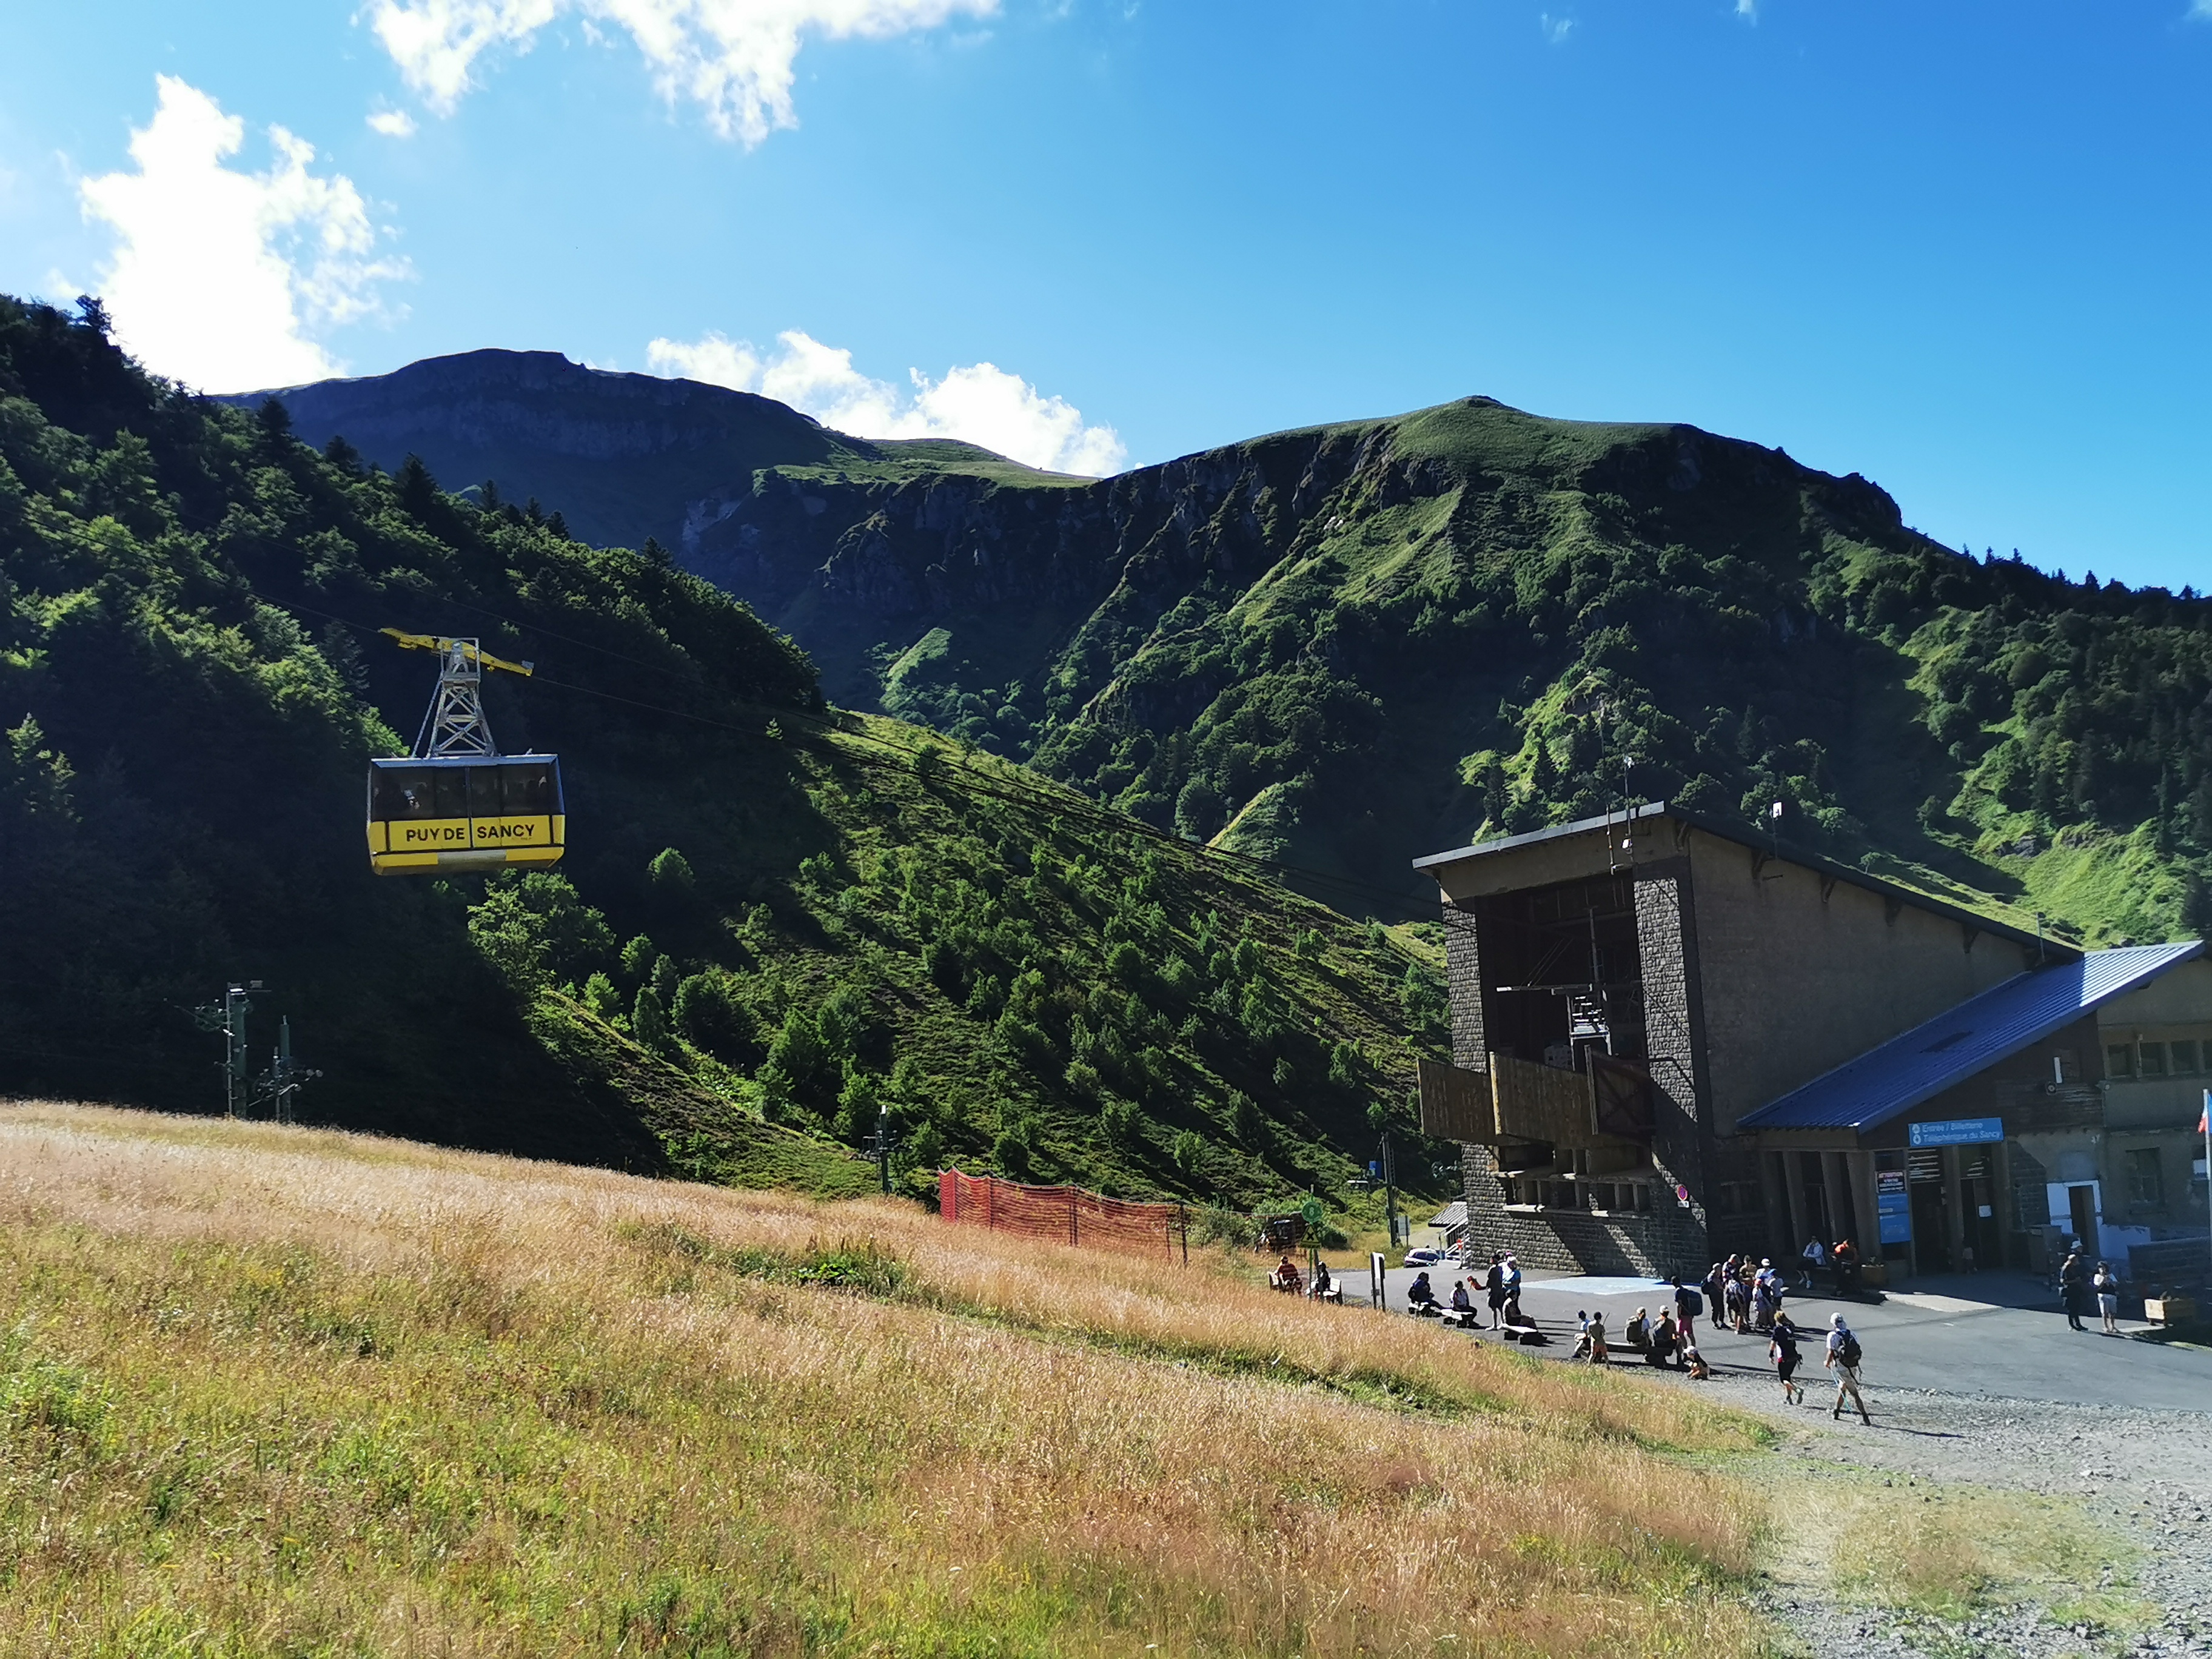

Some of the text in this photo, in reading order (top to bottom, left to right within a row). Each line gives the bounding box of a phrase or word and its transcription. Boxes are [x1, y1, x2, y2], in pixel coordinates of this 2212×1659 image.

[406, 824, 535, 842] PUY DE SANCY
